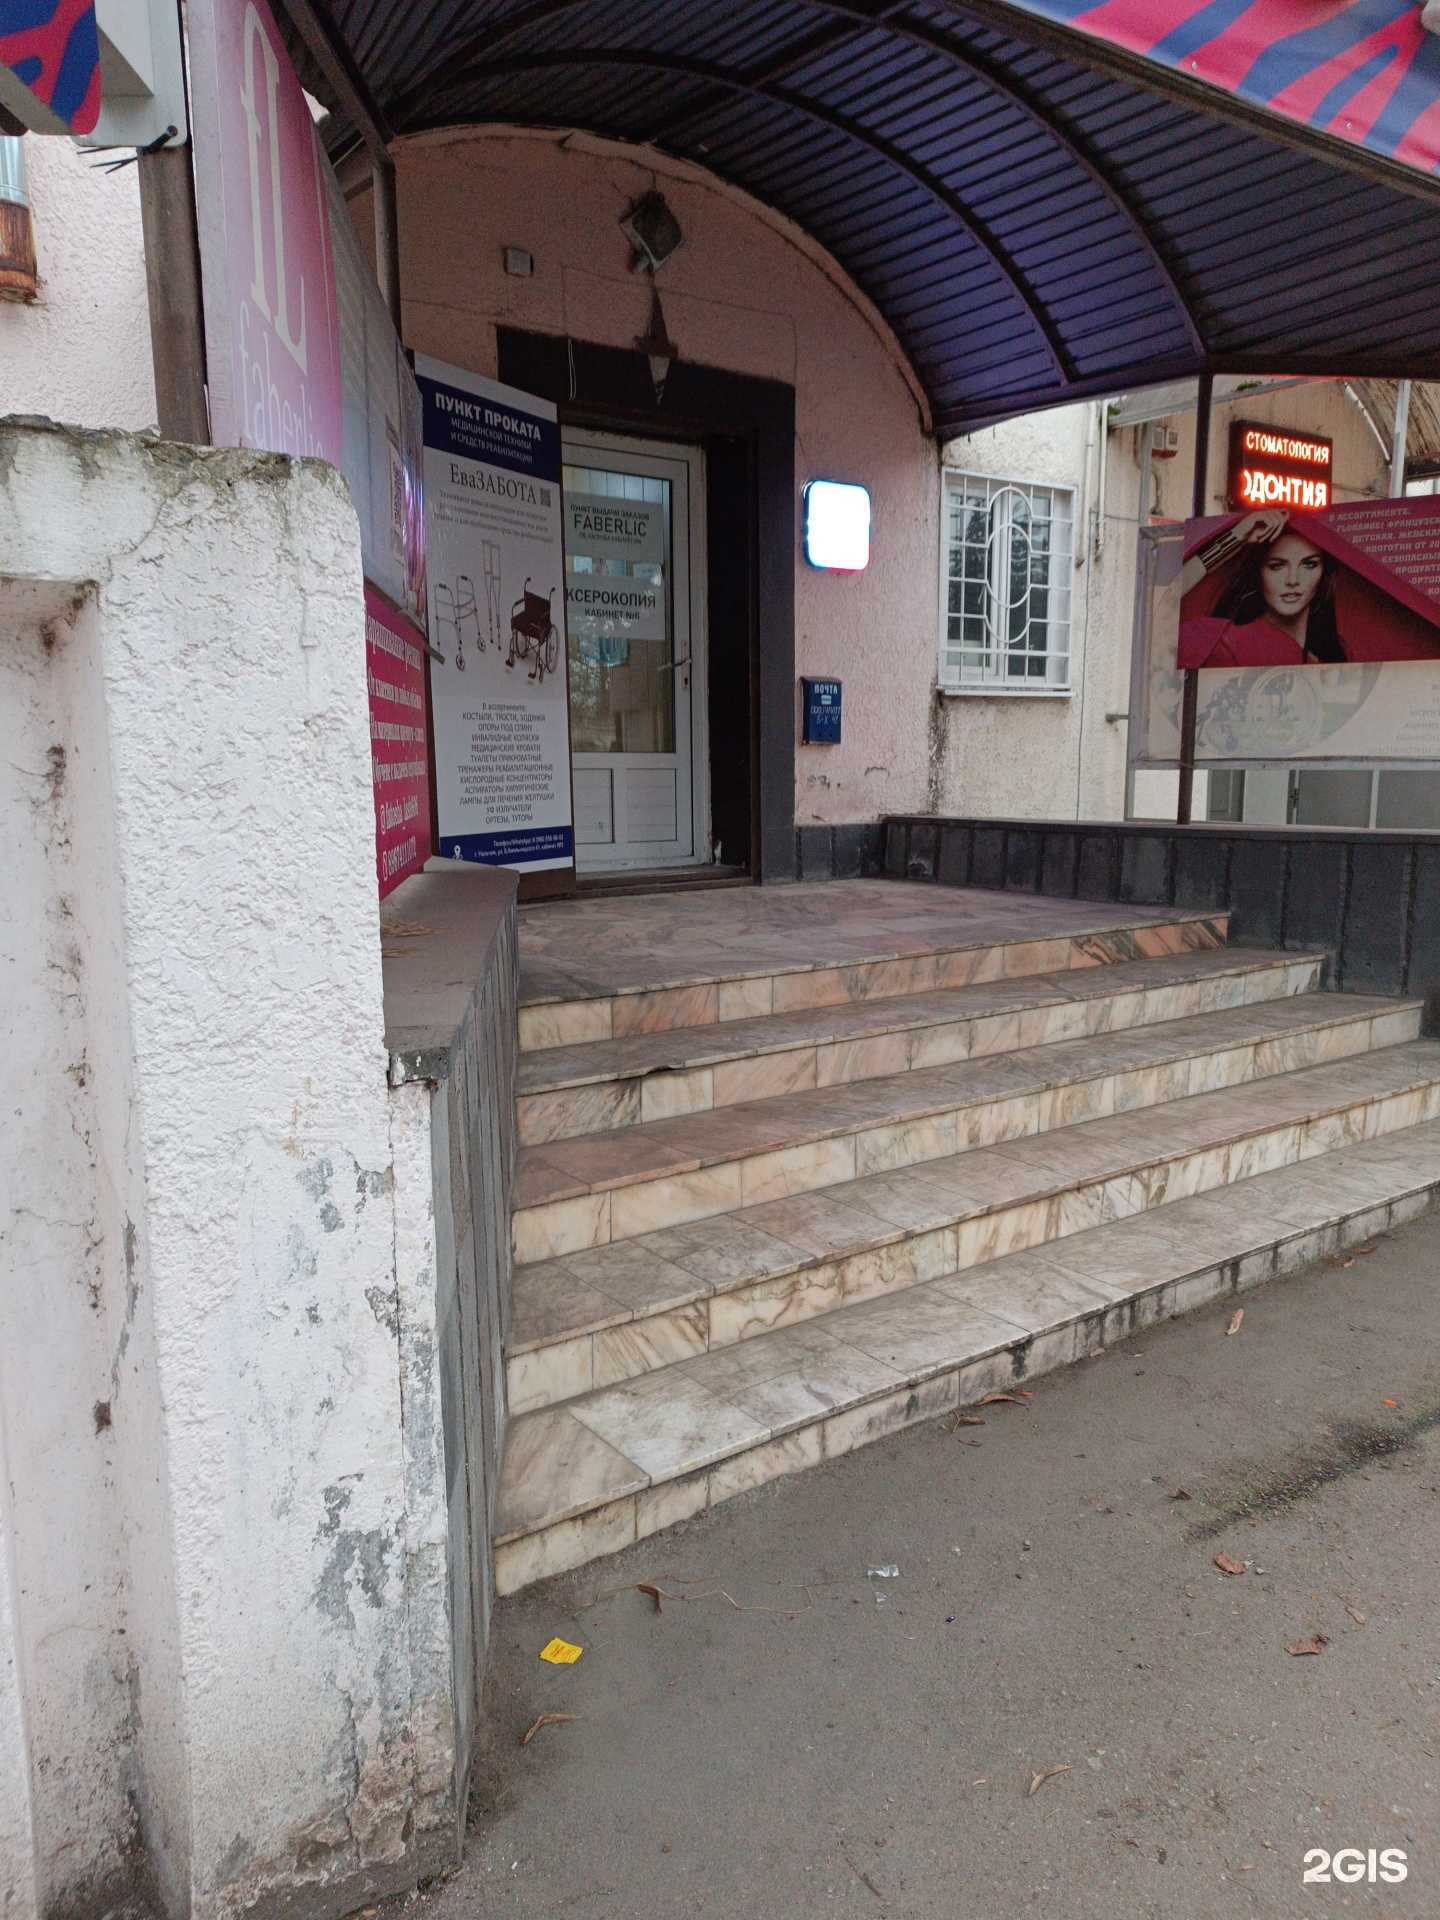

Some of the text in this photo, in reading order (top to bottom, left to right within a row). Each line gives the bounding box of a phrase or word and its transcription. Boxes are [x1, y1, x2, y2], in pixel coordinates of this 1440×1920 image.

[239, 301, 323, 459] faberli
[435, 392, 542, 441] ПУНКТ ПРОКАТА
[451, 417, 532, 449] МЕДИЦИНСКОЙ ТЕХНИКИ
[457, 433, 486, 451] СРЕДСТВ
[487, 441, 533, 464] РЕАБИЛИТАЦИИ
[1245, 430, 1330, 464] СТОМАТОЛОГИЯ
[449, 462, 537, 505] ЕваЗАБОТА
[570, 503, 649, 521] ПУНКТ ВЫДАЧИ ЗАКАЗОВ
[574, 513, 647, 537] FABERLIC
[566, 588, 656, 608] КСЕРОКОПИЯ
[585, 608, 624, 620] КАБИНЕТ
[814, 684, 838, 694] ПОЧТА
[462, 712, 495, 721] КОСТЫЛИ,
[495, 713, 518, 722] ТРОСТИ,
[478, 723, 499, 731] ОПОРЫ
[500, 724, 513, 732] ПОД
[472, 734, 511, 742] ИНВАЛИДНЫЕ
[472, 744, 540, 752] МЕДИЦИНСКИЕ КРОВАТИ
[470, 754, 542, 763] ТУАЛЕТЫ ПРИКРОВАТНЫЕ
[457, 764, 553, 773] ТРЕНАЖЕРЫ РЕАБИЛИТАЦИОННЫЕ
[460, 774, 553, 783] КИСЛОРОДНЫЕ КОНЦЕНТРАТОРЫ
[505, 784, 550, 792] ХИРУРГИЧЕСКИЕ
[460, 793, 555, 805] ЛАМПЫ ДЛЯ ЛЕЧЕНИЯ ЖЕЛТУШКИ
[496, 804, 531, 813] ИЗЛУЧАТЕЛИ
[485, 814, 533, 824] ОРТЕЗЫ, ТУТОРЫ
